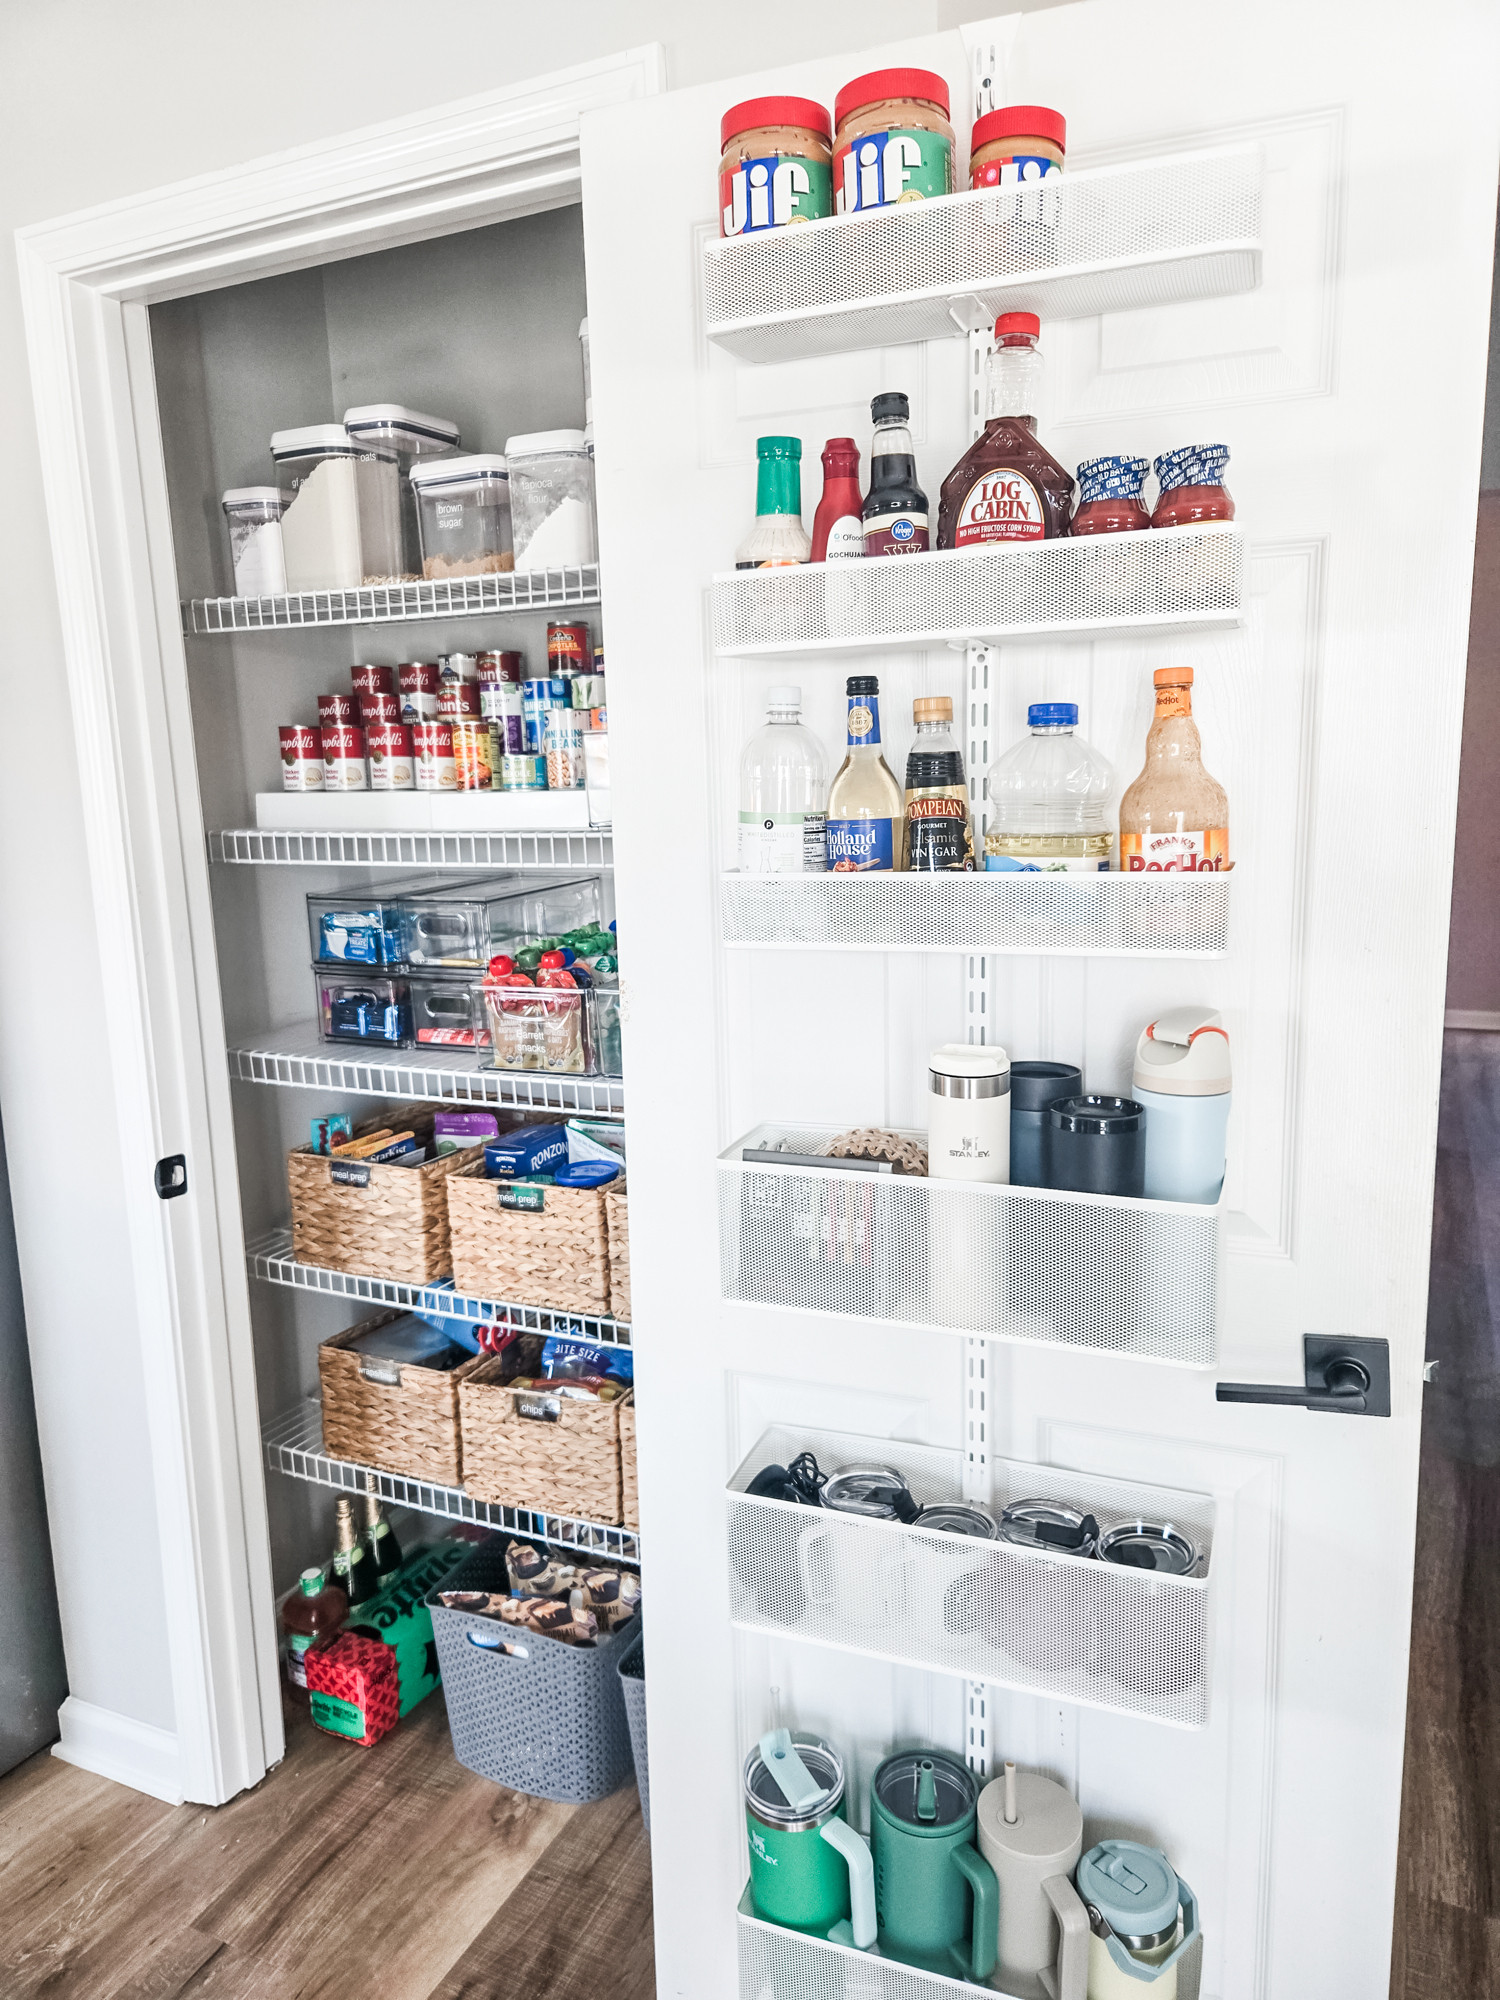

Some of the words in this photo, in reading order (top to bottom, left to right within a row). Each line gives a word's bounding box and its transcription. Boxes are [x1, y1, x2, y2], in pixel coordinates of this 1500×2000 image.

[836, 136, 922, 214] Jif
[723, 162, 810, 237] Jif
[360, 452, 377, 463] oats
[1098, 460, 1113, 471] BAY
[981, 481, 1021, 502] LOG
[438, 504, 463, 514] brown
[970, 500, 1031, 522] CABIN
[439, 519, 462, 529] sugar
[968, 526, 981, 536] HIGH
[981, 524, 1007, 533] FRUCTOSE
[1007, 524, 1022, 532] CORN
[1022, 524, 1041, 533] SYRUP
[827, 829, 876, 845] Holland
[1150, 836, 1196, 852] FRANK'S
[830, 844, 872, 859] House
[911, 846, 958, 858] VINGAR
[516, 1029, 545, 1040] Barrett
[517, 1044, 546, 1053] snacks
[530, 1141, 568, 1171] RONZON
[331, 1170, 349, 1179] meal
[350, 1172, 367, 1182] prep
[497, 1193, 516, 1202] meal
[518, 1195, 537, 1206] prep
[555, 1344, 576, 1354] BITE
[579, 1347, 600, 1362] SIZE
[521, 1403, 543, 1415] chips
